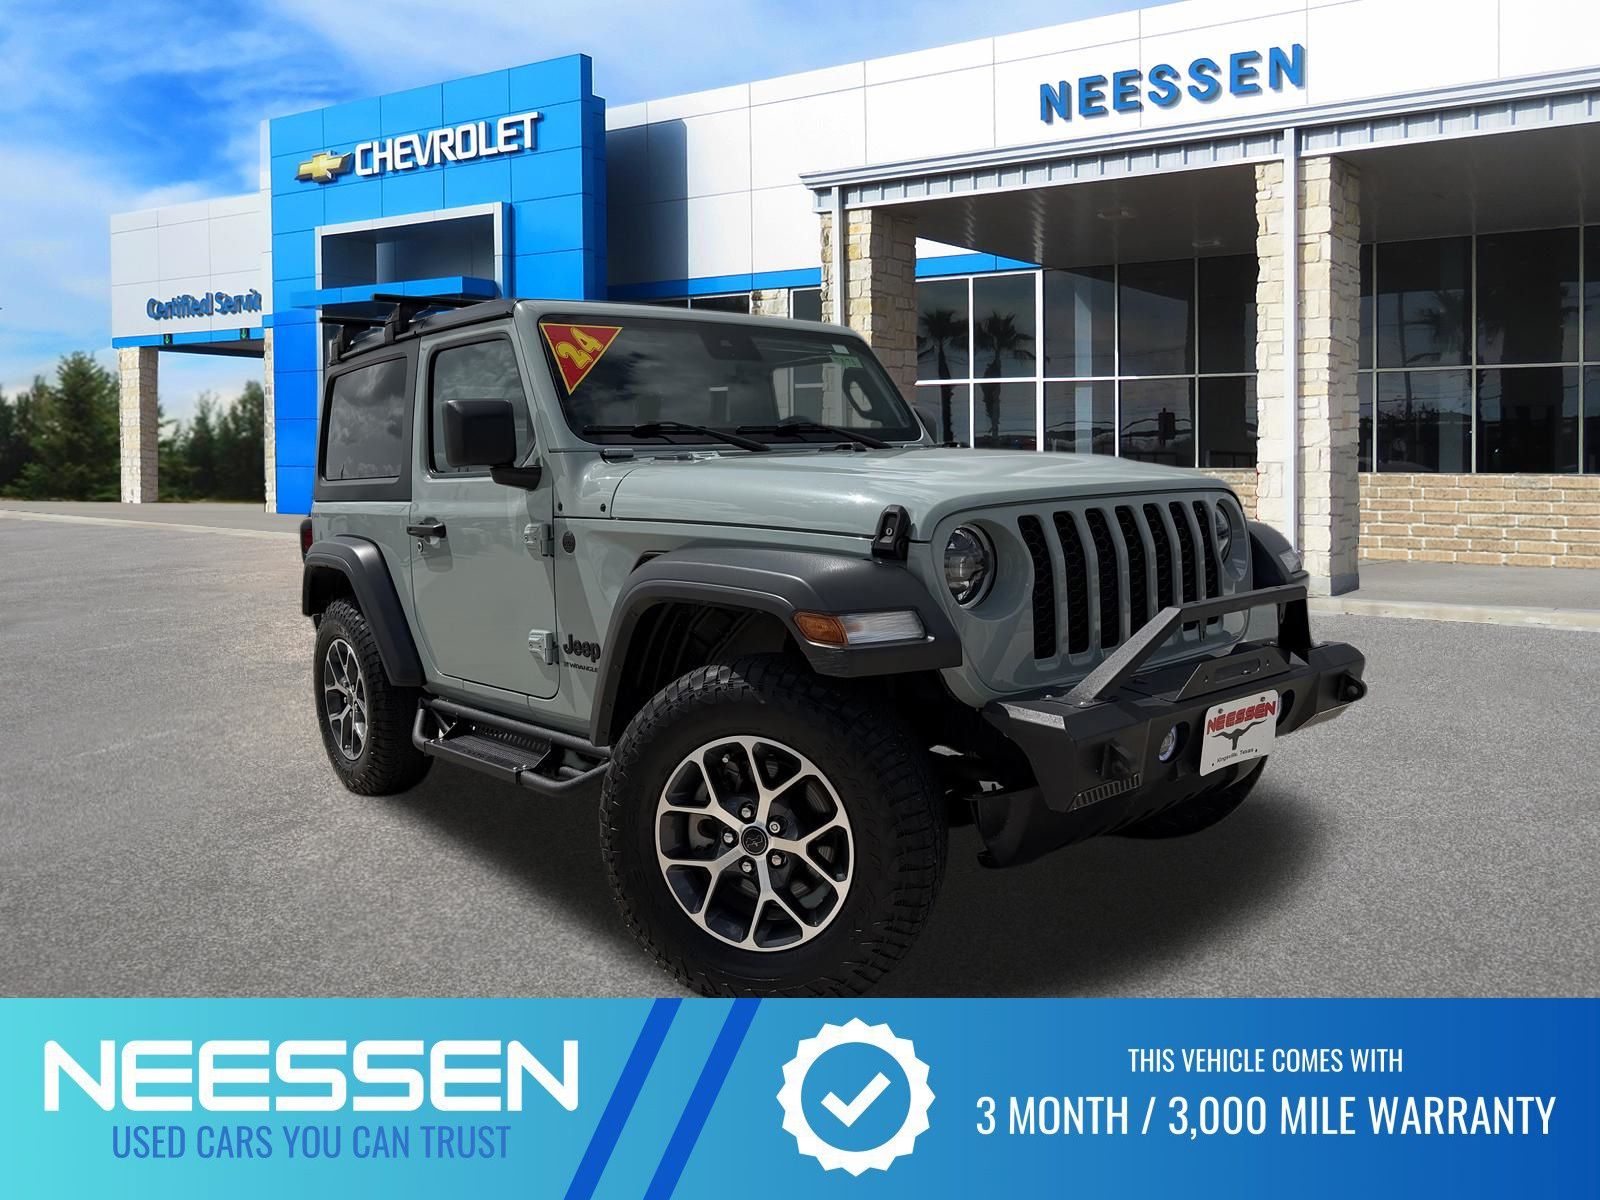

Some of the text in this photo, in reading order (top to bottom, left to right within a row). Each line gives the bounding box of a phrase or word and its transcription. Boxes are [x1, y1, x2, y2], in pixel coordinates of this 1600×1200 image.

[1040, 43, 1305, 124] NEESSEN
[355, 111, 544, 177] CHEVROLET
[147, 291, 214, 320] Certified
[555, 326, 604, 369] 24
[562, 632, 601, 664] Jeep
[1206, 700, 1277, 736] NEESSEN
